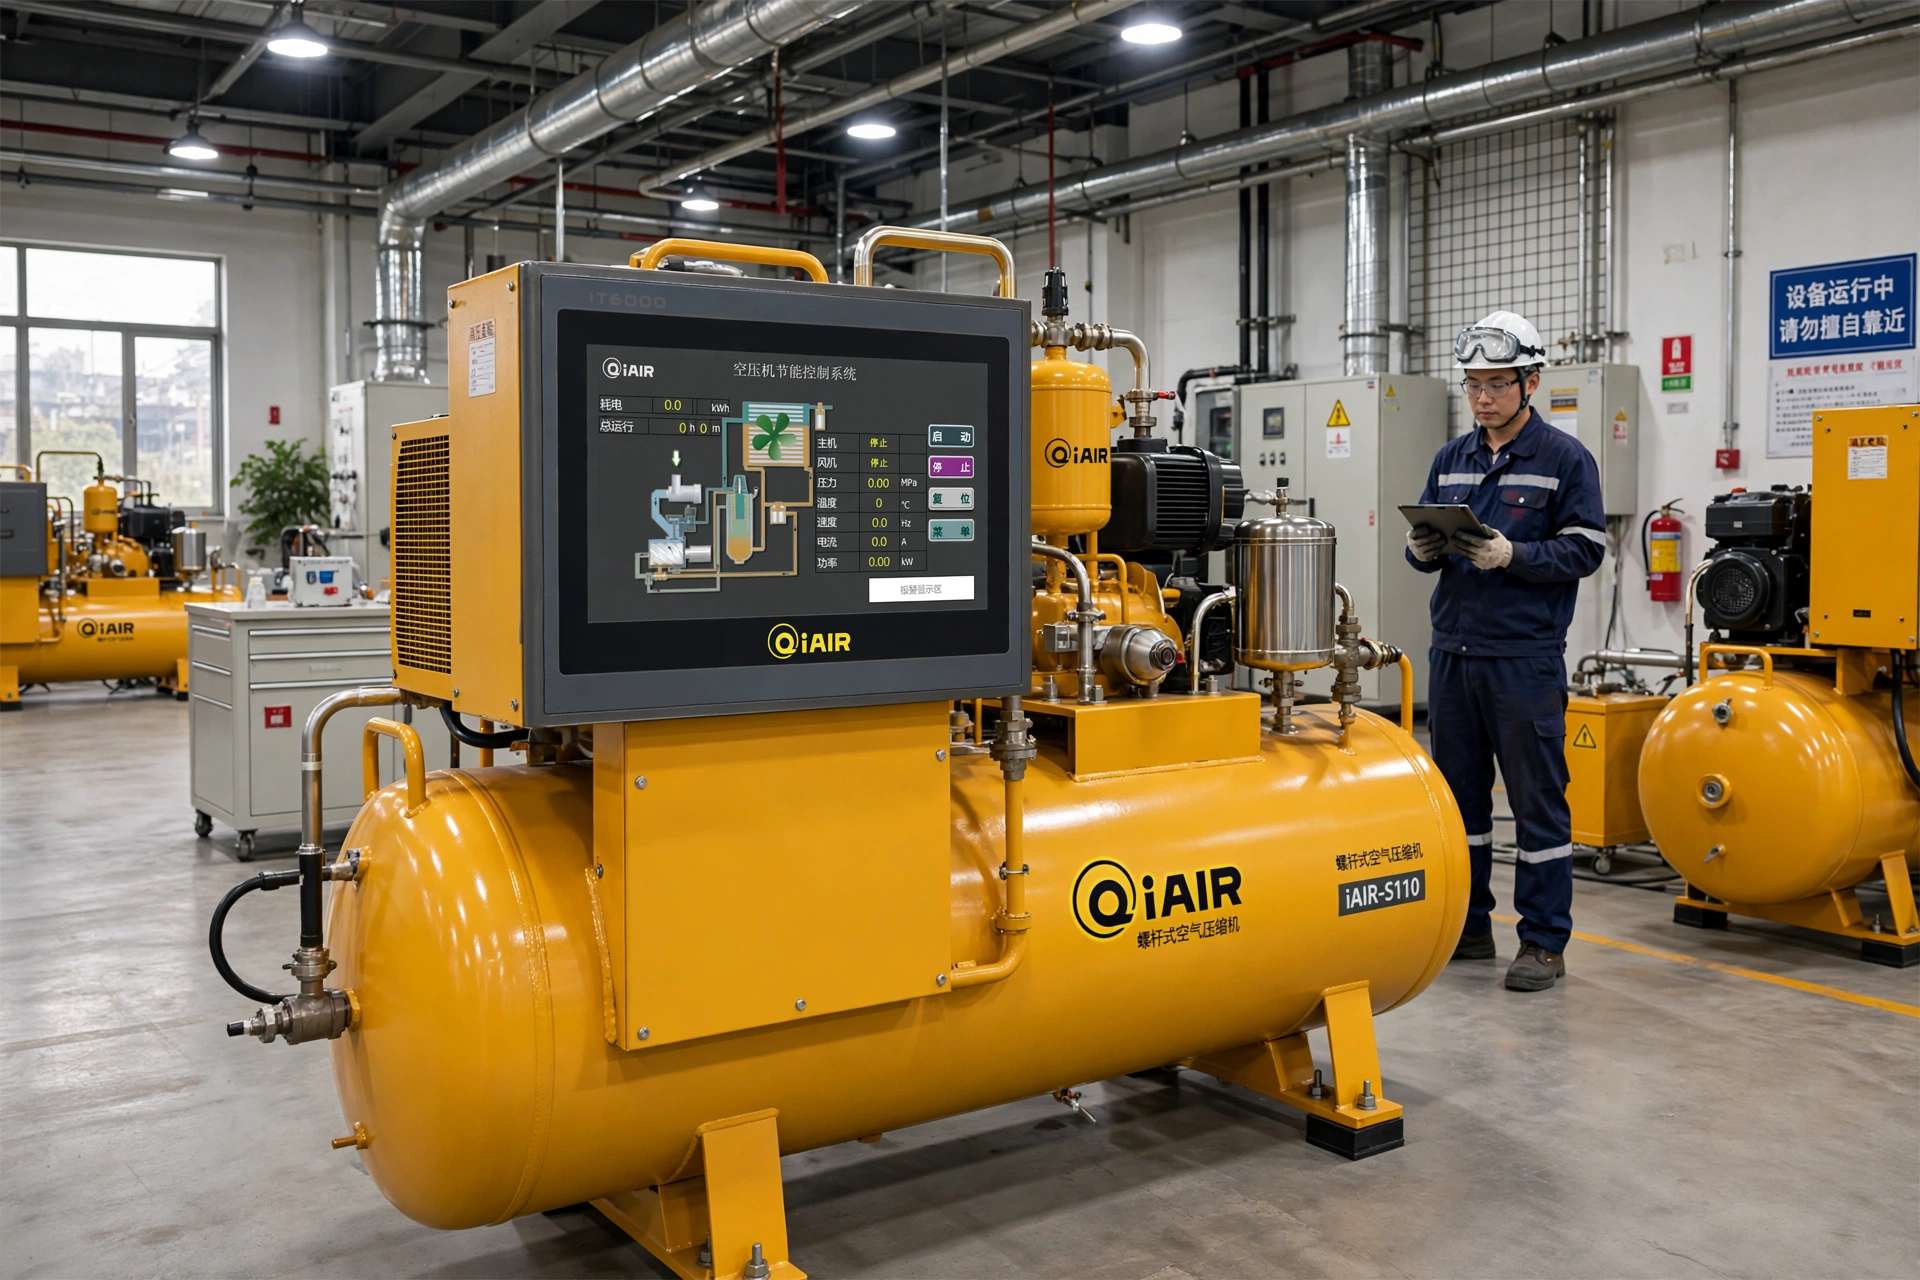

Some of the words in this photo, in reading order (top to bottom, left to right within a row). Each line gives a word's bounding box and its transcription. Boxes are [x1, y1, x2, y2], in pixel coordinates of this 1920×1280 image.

[1786, 274, 1894, 310] 设备运行中
[588, 291, 666, 309] IT6000
[1779, 306, 1906, 343] 请勿擅自靠近
[733, 361, 857, 382] 空压机节能控制系统
[599, 398, 623, 412] 耗电
[664, 399, 682, 412] 0.0
[711, 402, 730, 414] kWh
[599, 420, 634, 433] 总运行
[689, 420, 695, 433] h
[712, 424, 720, 433] m
[817, 437, 838, 449] 主机
[869, 438, 888, 448] 停止
[932, 430, 971, 443] 启动
[817, 457, 838, 468] 风机
[870, 458, 888, 468] 停止
[932, 461, 971, 473] 停止
[817, 478, 837, 488] 压力
[867, 477, 890, 489] 0.00
[901, 478, 918, 487] MPa
[817, 497, 837, 509] 温度
[875, 498, 883, 508] 0
[817, 516, 837, 528] 速度
[872, 517, 888, 528] 0.0
[901, 519, 911, 527] Hz
[817, 537, 838, 548] 电流
[871, 536, 887, 547] 0.0
[901, 537, 907, 546] A
[817, 557, 838, 569] 功率
[868, 556, 890, 567] 0.00
[901, 557, 914, 566] kW
[1335, 843, 1423, 871] 螺杆式空气压缩机
[1345, 877, 1420, 910] iAIR-S110
[1137, 915, 1240, 949] 螺杆式空气压缩机
